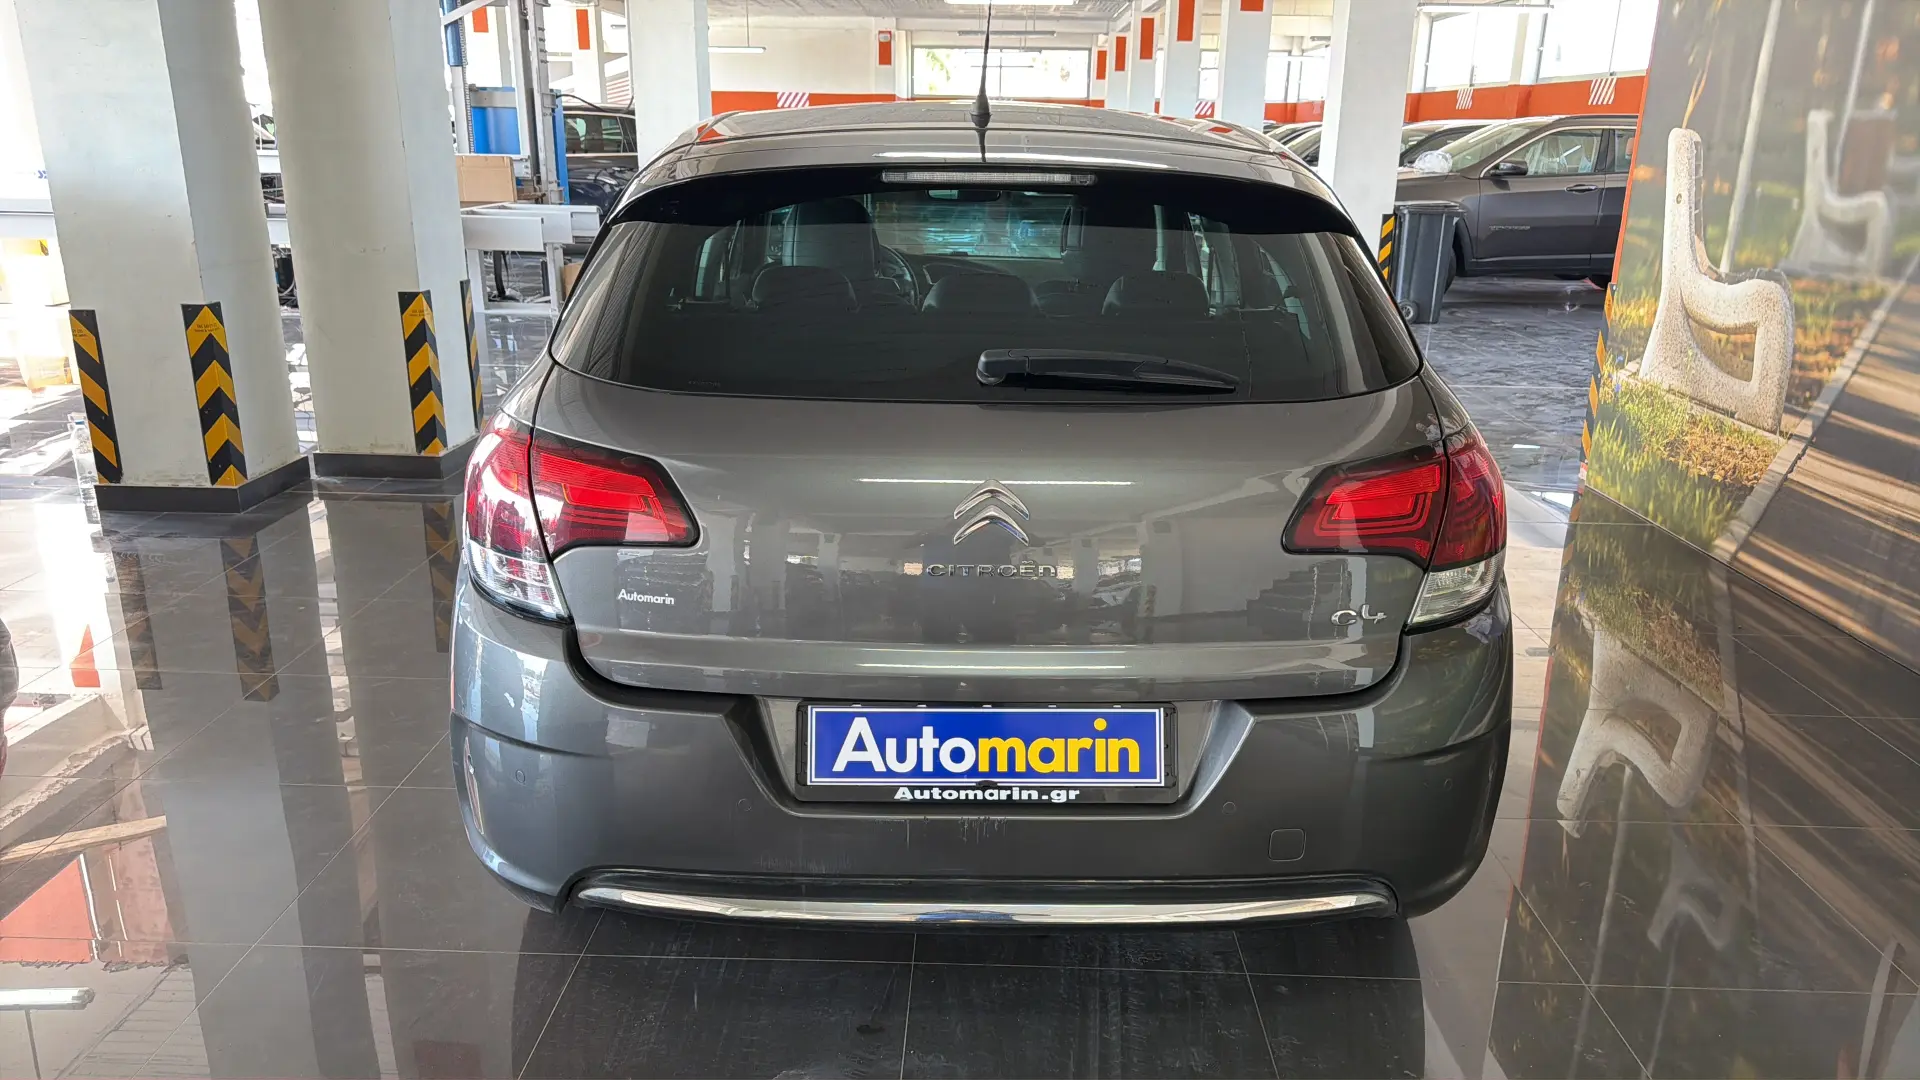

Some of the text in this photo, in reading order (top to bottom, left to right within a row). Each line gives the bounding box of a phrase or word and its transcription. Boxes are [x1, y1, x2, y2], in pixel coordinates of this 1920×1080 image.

[616, 588, 675, 605] Automarin
[1331, 604, 1388, 625] C4
[832, 717, 1140, 773] Automarin
[893, 786, 1080, 803] Automarin.gr
